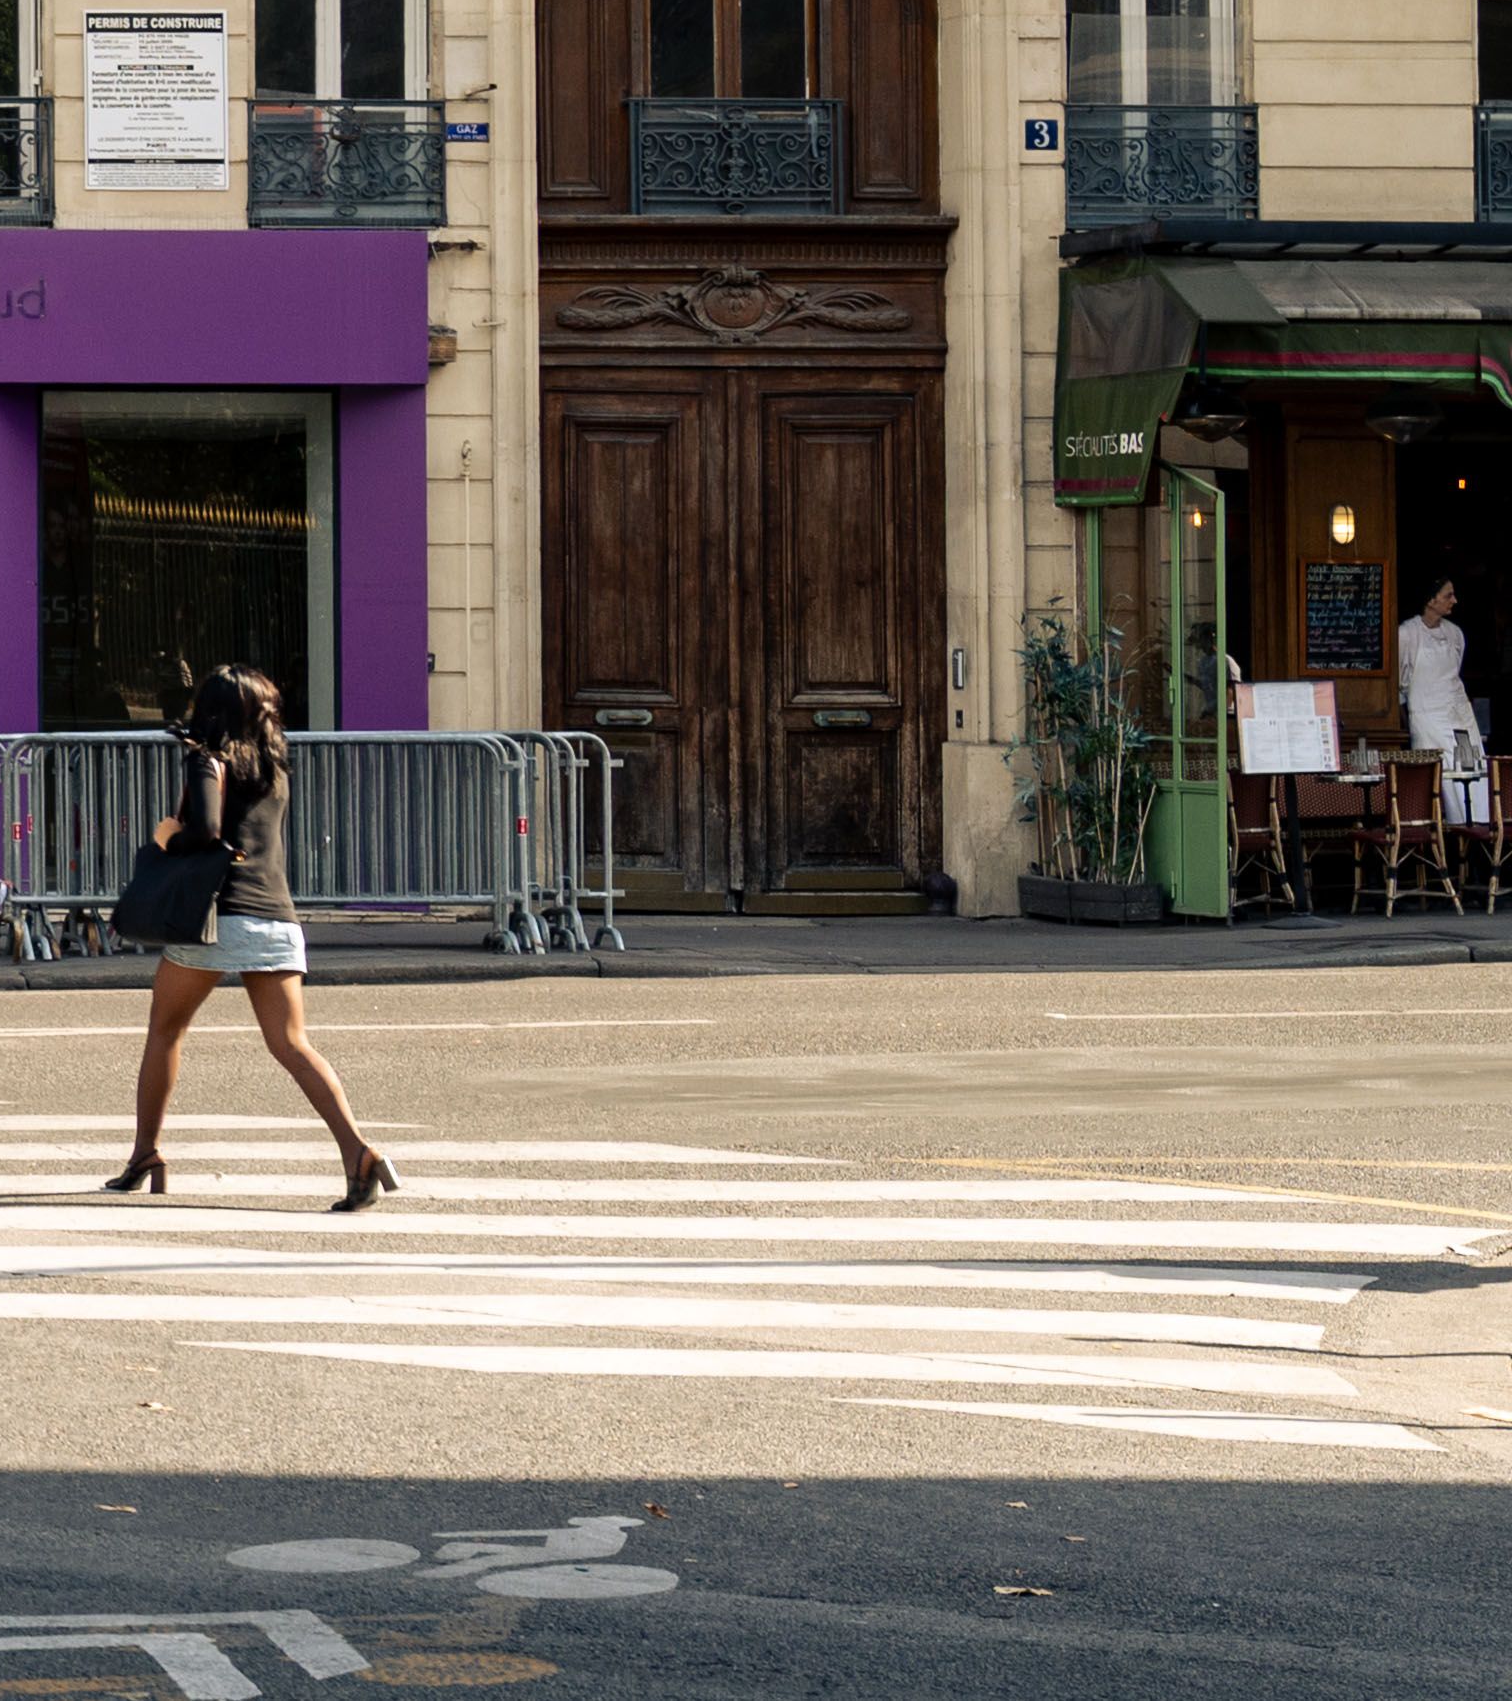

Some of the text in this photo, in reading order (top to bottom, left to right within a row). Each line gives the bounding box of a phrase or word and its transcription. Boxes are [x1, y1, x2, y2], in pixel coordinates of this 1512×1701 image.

[88, 18, 222, 28] PERMIS DE CONSTRUIRE
[456, 124, 478, 134] GAZ
[1033, 121, 1051, 148] 3
